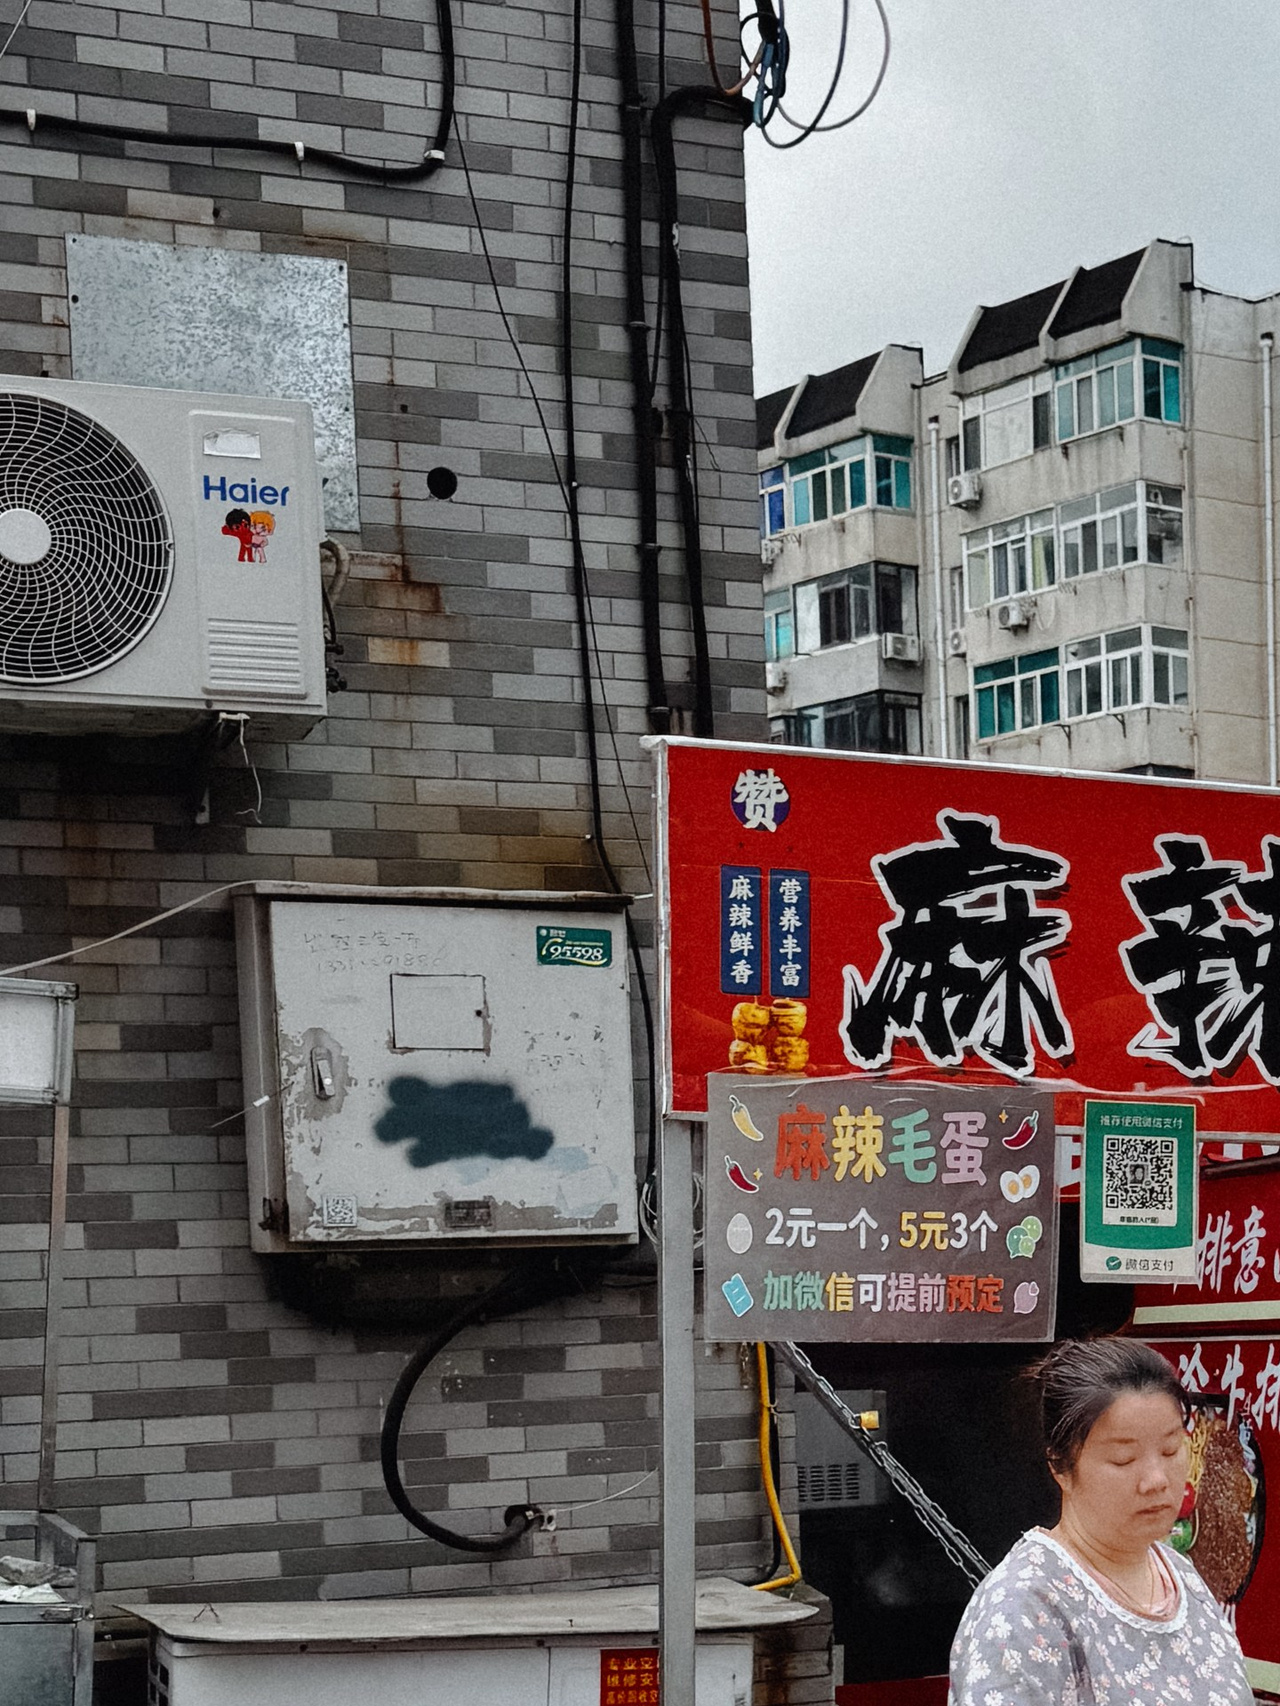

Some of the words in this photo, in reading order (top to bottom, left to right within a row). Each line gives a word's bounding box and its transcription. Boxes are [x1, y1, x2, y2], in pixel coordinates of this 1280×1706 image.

[203, 475, 289, 506] Haier
[733, 768, 789, 832] 赞
[728, 875, 755, 985] 麻辣鲜香
[778, 878, 803, 987] 营养丰富
[550, 946, 604, 961] 95598
[774, 1103, 990, 1187] 麻辣毛蛋
[1125, 1258, 1174, 1272] 微信支付
[762, 1268, 1005, 1313] 加微信可提前预定
[607, 1658, 658, 1671] 专业空
[607, 1673, 658, 1687] 维修安
